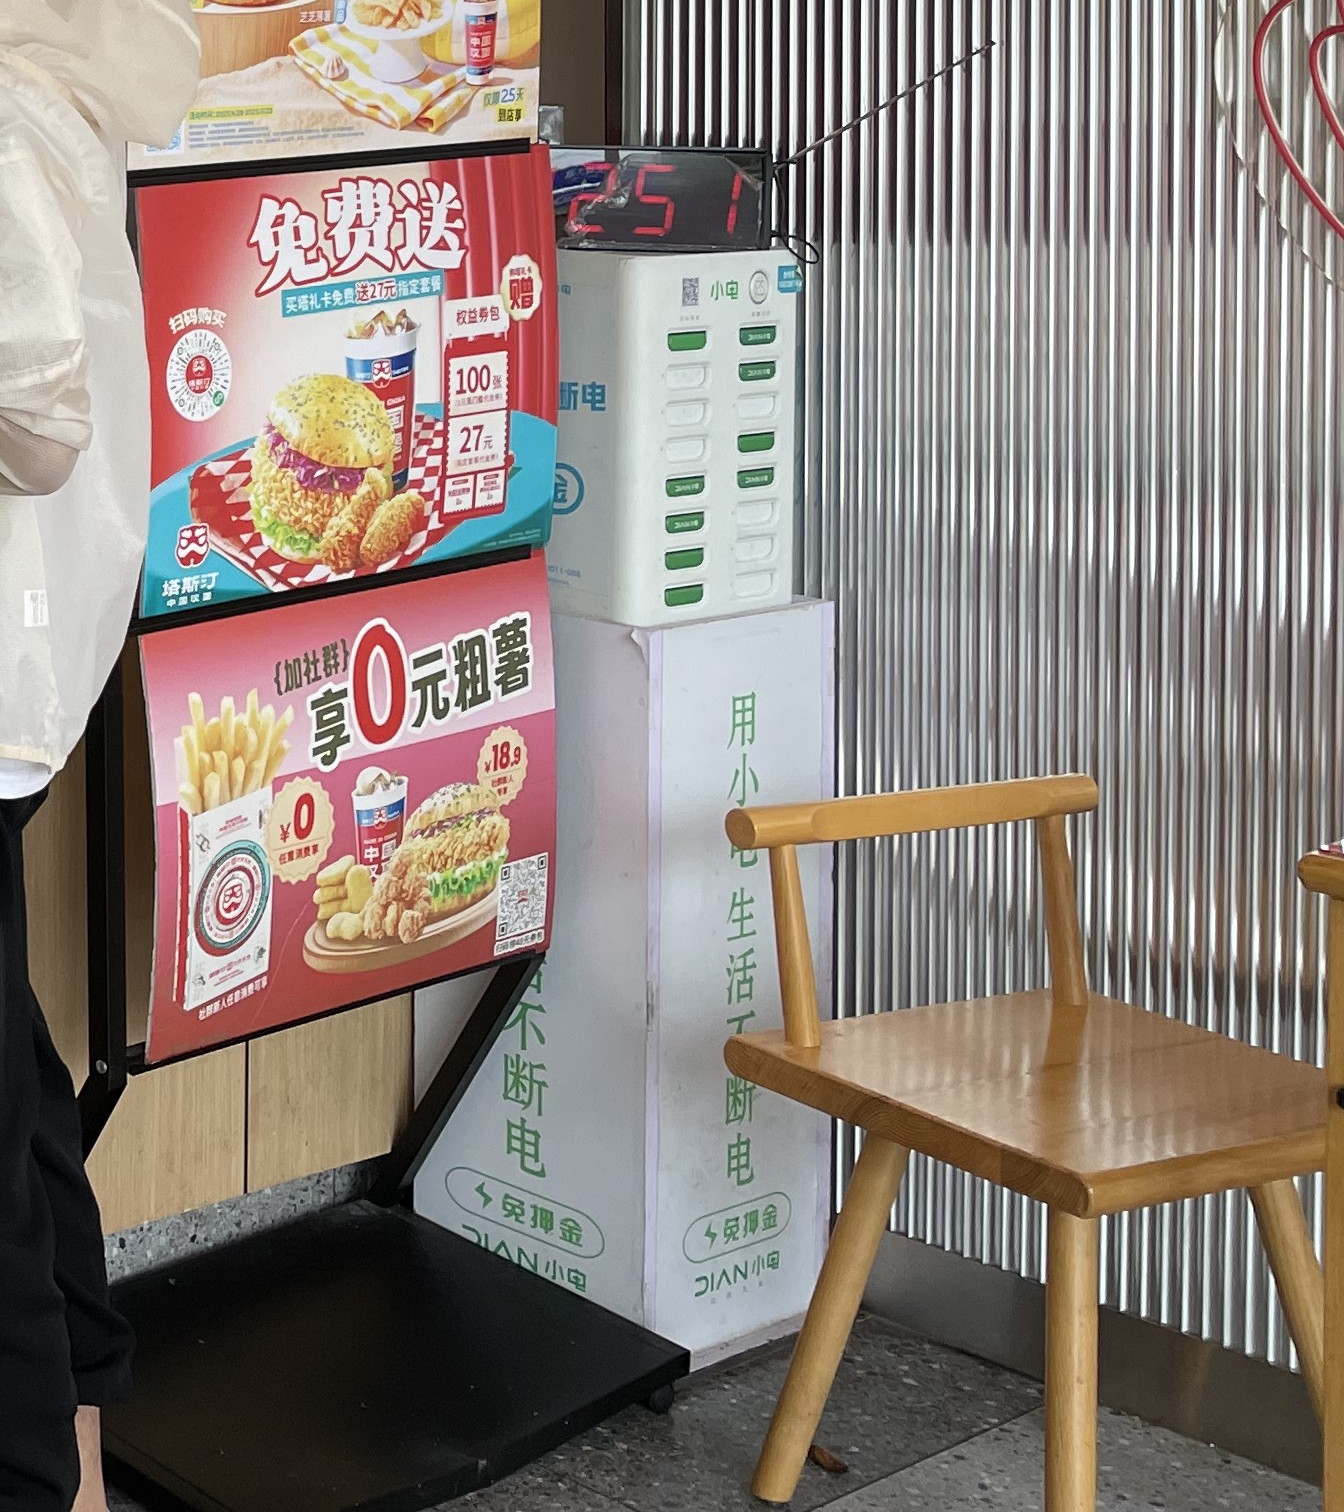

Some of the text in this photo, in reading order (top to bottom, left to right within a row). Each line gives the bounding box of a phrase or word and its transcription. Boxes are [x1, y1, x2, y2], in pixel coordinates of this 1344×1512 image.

[248, 176, 469, 296] 免费送
[711, 279, 739, 301] 小电
[168, 307, 228, 334] 扫码购买
[455, 305, 501, 326] 权益券包
[162, 571, 220, 599] 塔斯汀
[484, 740, 521, 774] ¥18.9
[279, 792, 316, 844] ¥0
[501, 954, 549, 1179] 不断电
[502, 1191, 585, 1248] 免押金
[723, 1197, 780, 1245] 免押金
[544, 1257, 588, 1293] 小电
[750, 1249, 781, 1281] 小电
